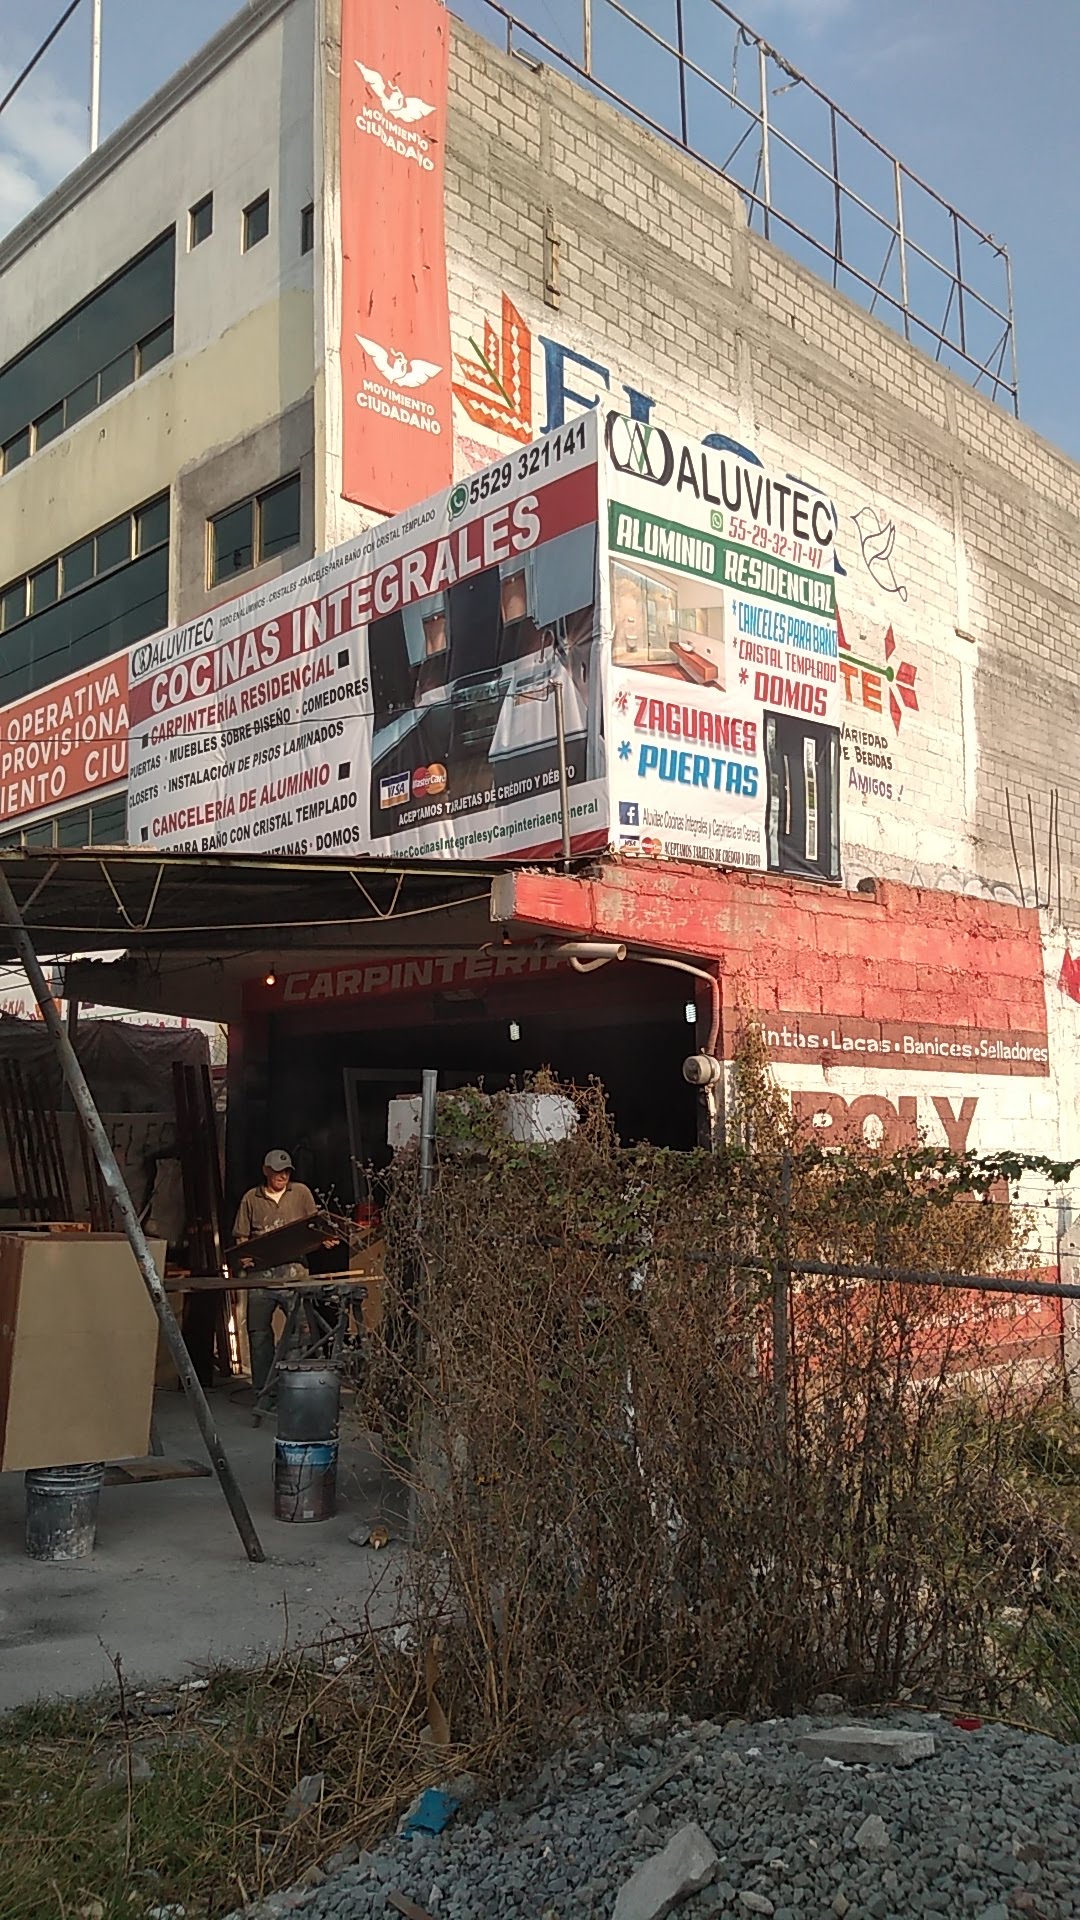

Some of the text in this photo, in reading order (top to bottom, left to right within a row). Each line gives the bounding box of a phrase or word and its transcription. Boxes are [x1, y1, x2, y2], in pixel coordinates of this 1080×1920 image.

[355, 115, 435, 171] CIUDADANO
[362, 106, 429, 151] MOVIMIENTO
[356, 392, 441, 435] CIUDADANO
[362, 379, 436, 416] MOVIMIENTO
[469, 421, 586, 505] 5529 321141
[676, 445, 833, 547] ALUVITEC
[269, 581, 297, 603] CRISTALES
[376, 528, 400, 548] CRISTAL
[402, 508, 436, 536] TEMPLADO
[616, 513, 834, 613] ALUMINIO RESIDENCIAL
[151, 494, 541, 713] COCINAS INTEGRALES
[739, 601, 786, 644] CANCELES
[787, 616, 811, 652] PARA
[151, 617, 213, 668] ALUVITEC
[739, 639, 837, 683] CRISTAL TEMPLADO
[7, 672, 120, 745] OPERATIVA
[151, 654, 335, 747] CARPINTERÍA RESIDENCIAL
[754, 671, 828, 717] DOMOS
[2, 703, 129, 779] PROVISIONA
[130, 677, 369, 780] PUERTAS MUEBLES SOBRE DISEÑO COMEDORES
[634, 695, 757, 752] ZAGUANES
[85, 740, 126, 782] CIU
[129, 720, 344, 809] CLOSETS INSTALACIÓN DE PISOS LAMINADOS
[638, 744, 759, 797] PUERTAS
[854, 745, 893, 770] BEBIDAS
[152, 763, 330, 838] CANCELERÍA DE ALUMINIO
[387, 782, 405, 798] VISA
[398, 765, 575, 826] ACEPTAMOS TARJETAS DE CRÉDITO Y DÉBO
[201, 831, 228, 852] BAÑO
[230, 824, 250, 844] CON
[252, 811, 293, 837] CRISTAL
[296, 791, 358, 824] TEMPLADO
[315, 825, 360, 852] DOMOS
[642, 808, 663, 828] Aluvitec
[664, 810, 684, 831] Cocinas
[684, 813, 707, 838] Integrales
[743, 824, 761, 843] General
[831, 1030, 891, 1053] Lacas
[903, 1035, 972, 1057] Banices
[980, 1039, 1048, 1062] Selladores
